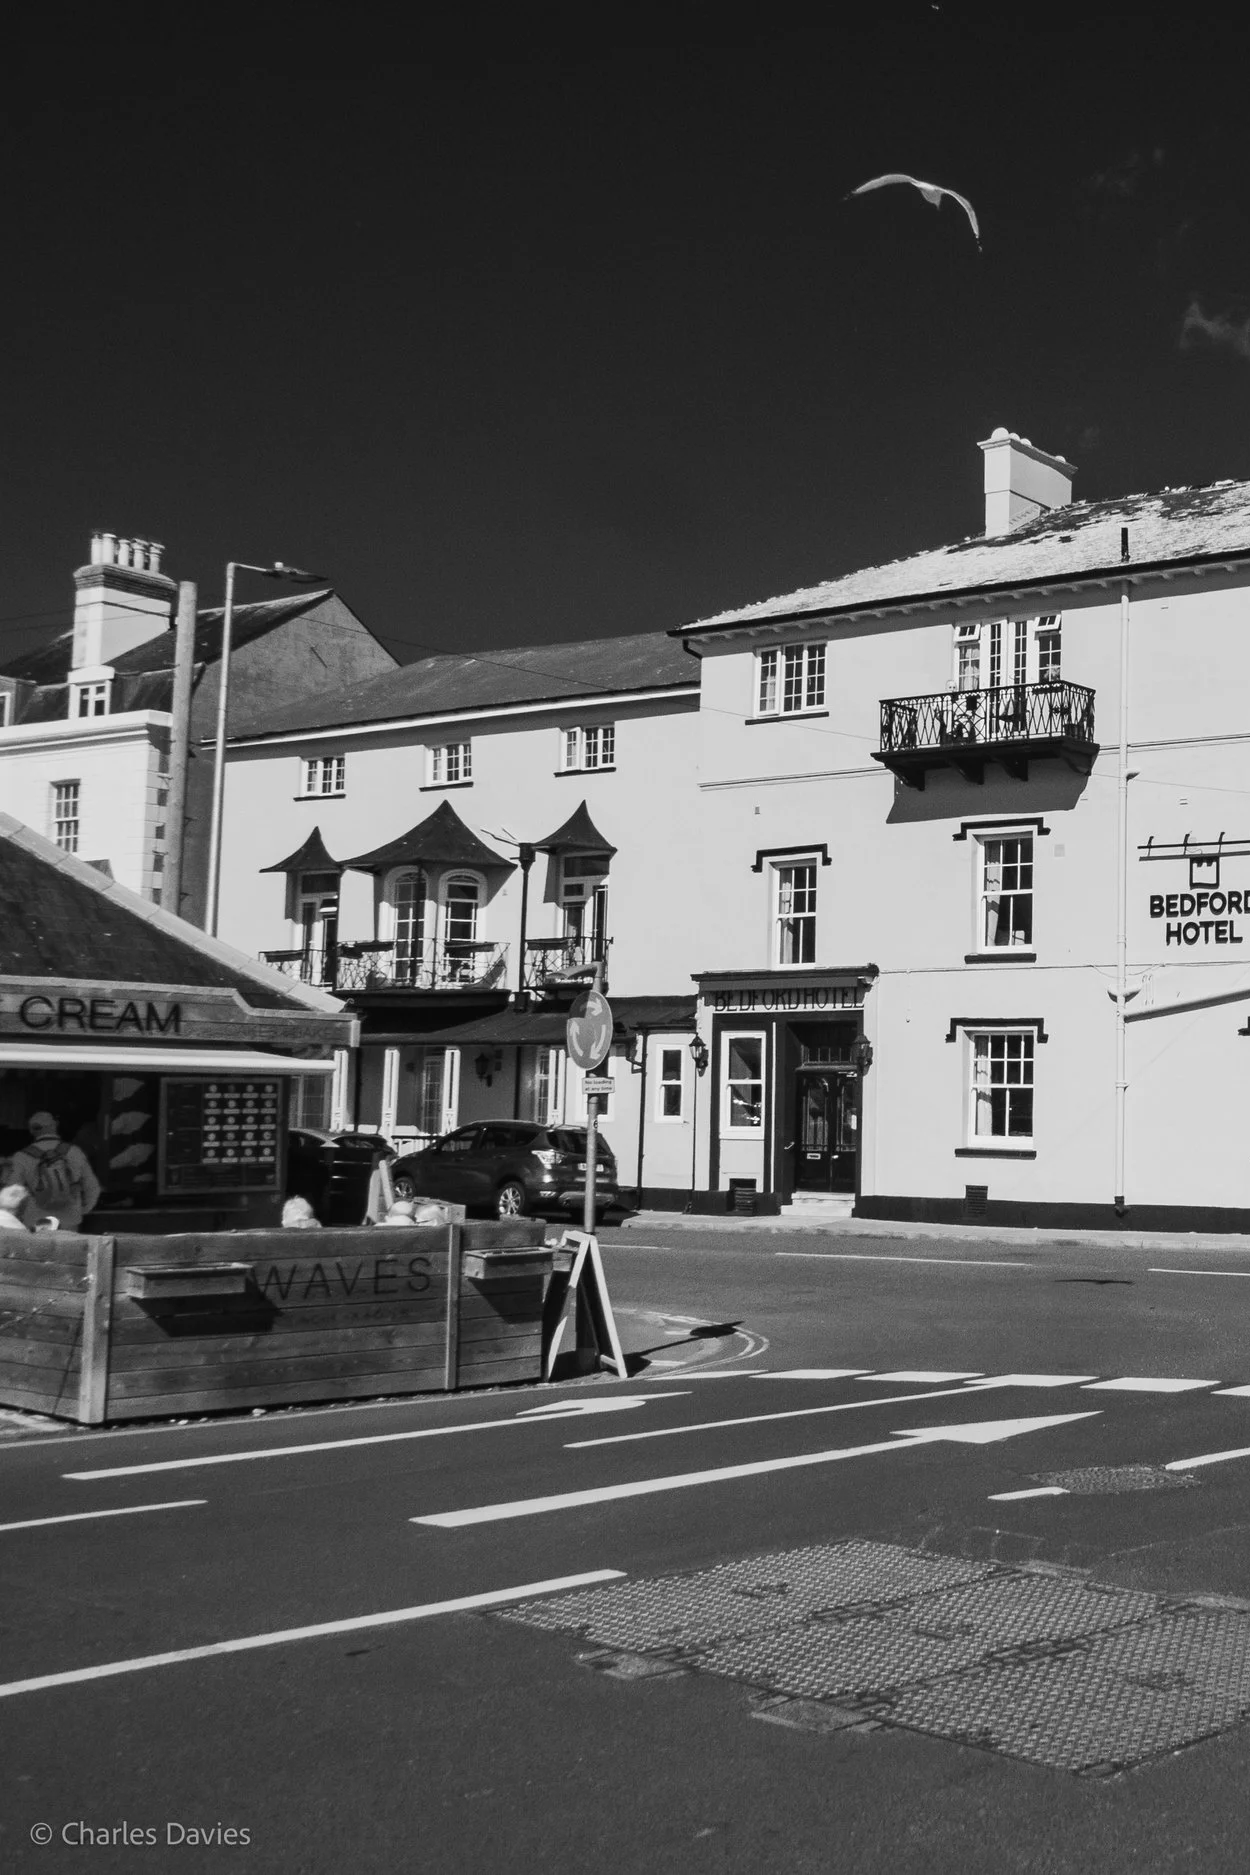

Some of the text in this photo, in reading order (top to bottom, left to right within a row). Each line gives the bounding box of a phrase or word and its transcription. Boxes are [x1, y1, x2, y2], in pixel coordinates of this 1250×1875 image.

[1166, 920, 1243, 946] HOTEL
[18, 995, 182, 1033] CREAM
[714, 987, 864, 1012] BEDFORD HOTEL
[251, 1256, 432, 1301] WAVES
